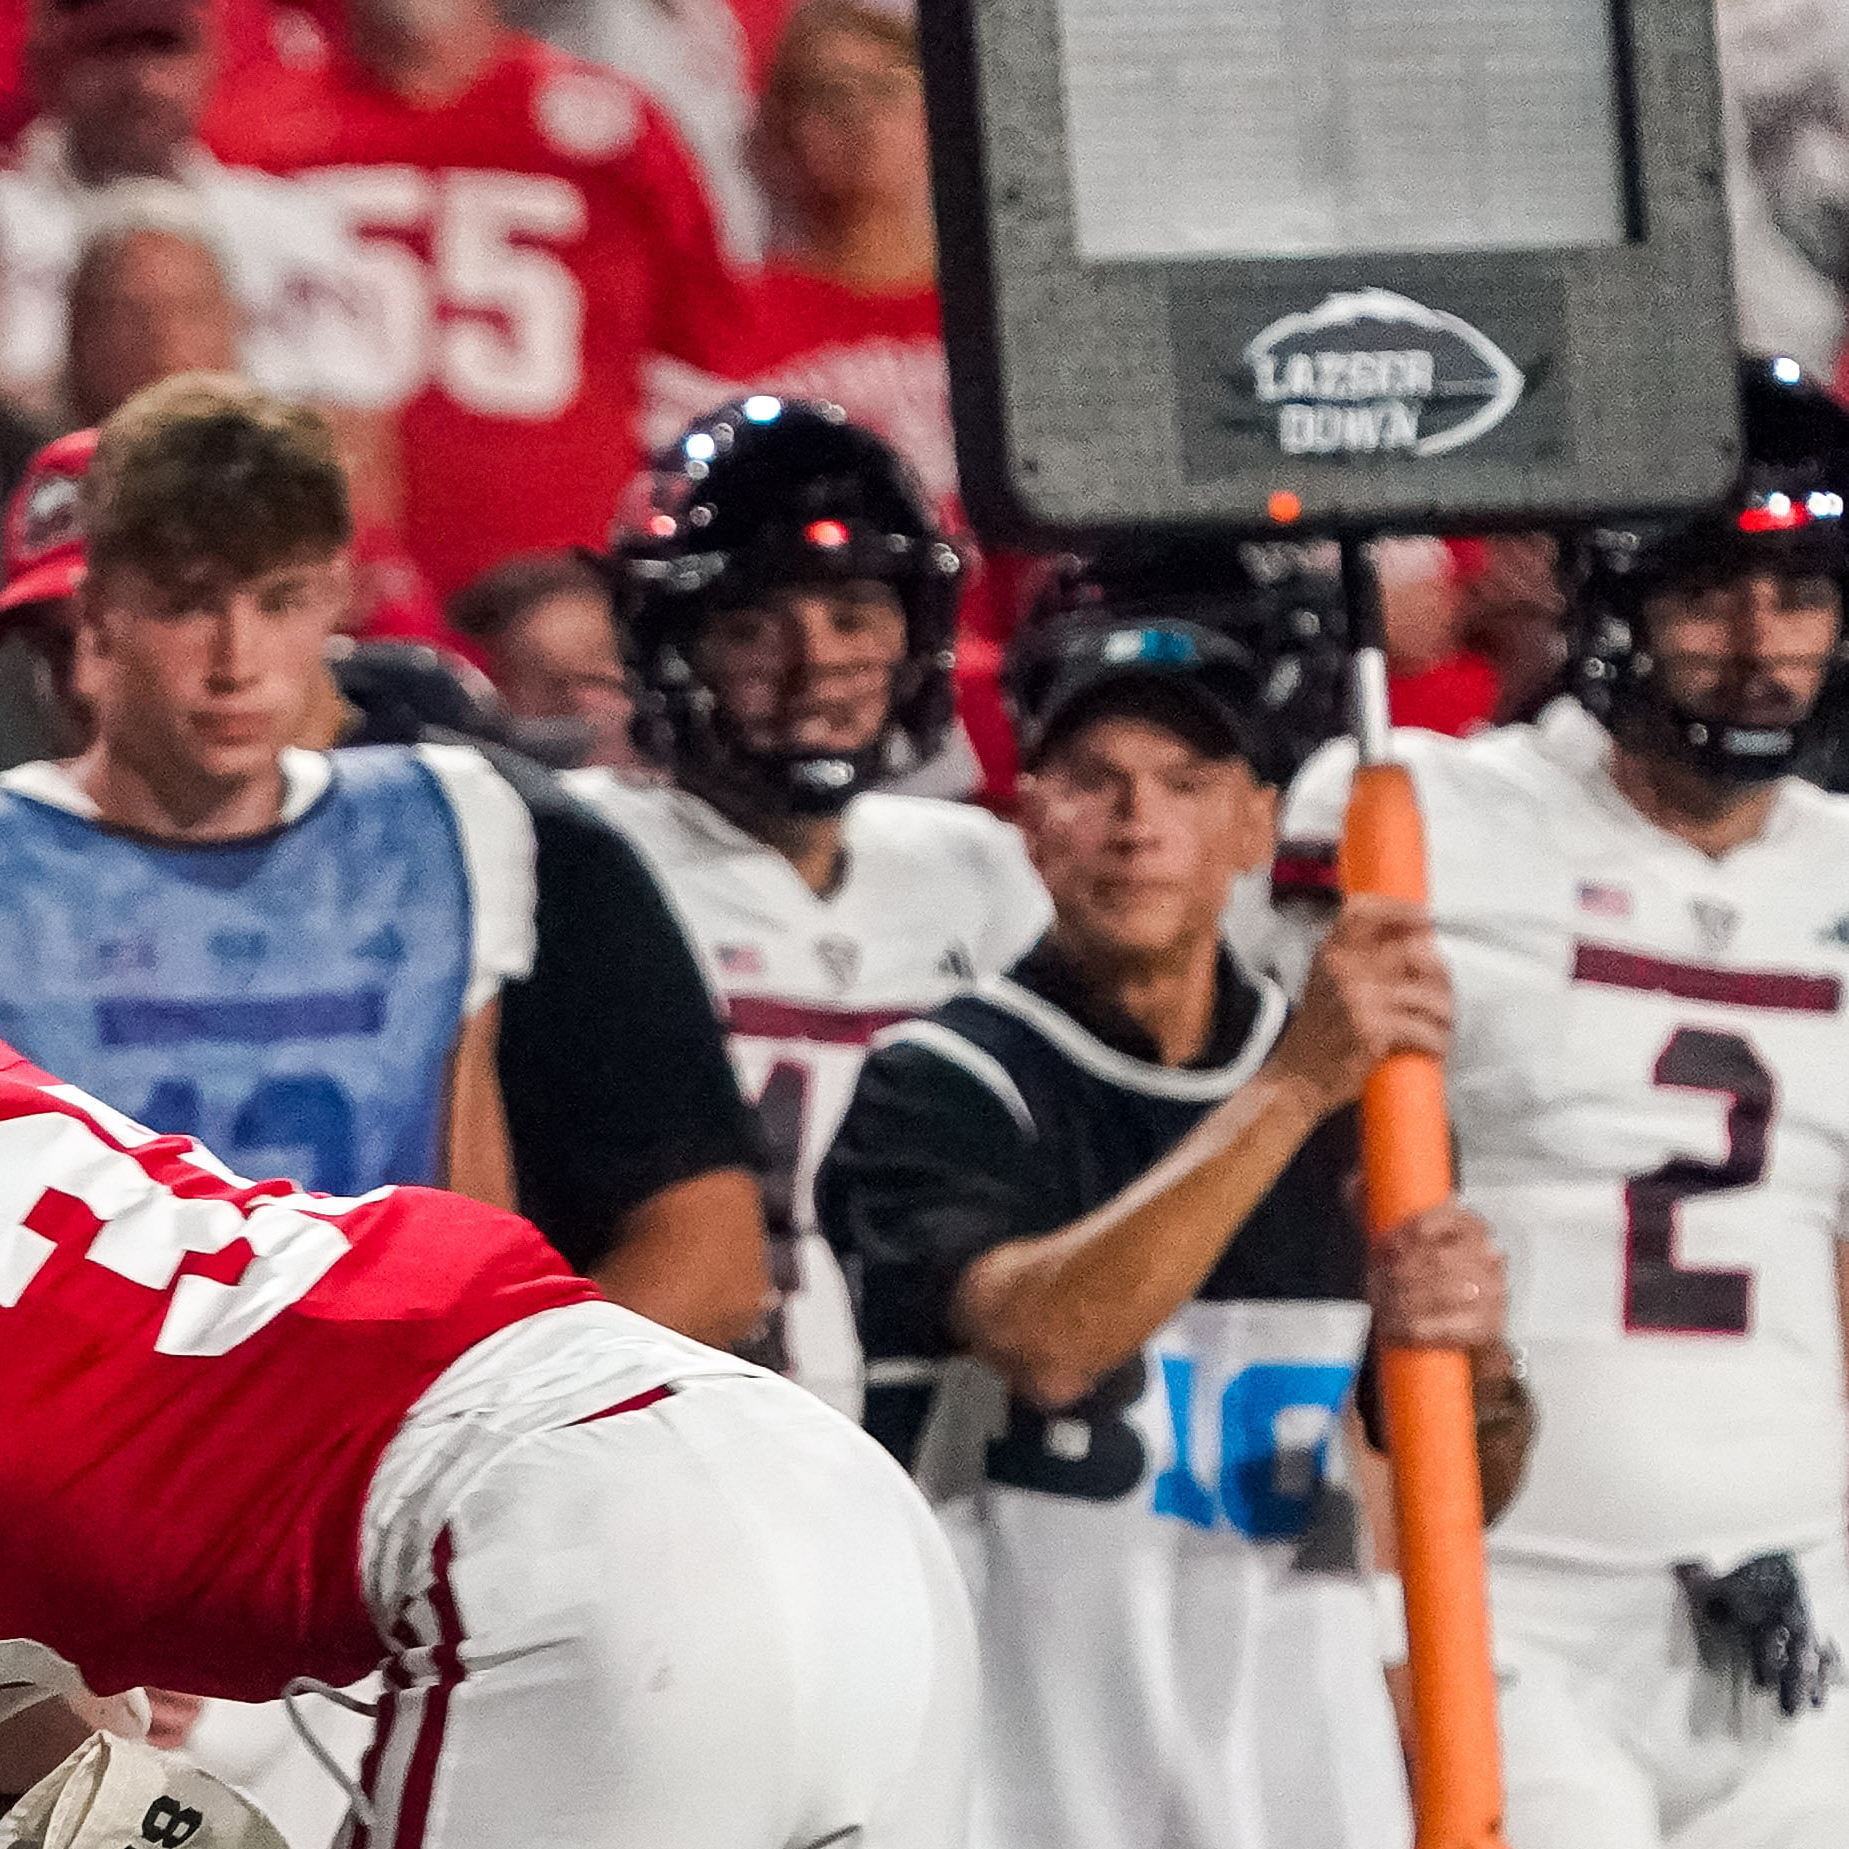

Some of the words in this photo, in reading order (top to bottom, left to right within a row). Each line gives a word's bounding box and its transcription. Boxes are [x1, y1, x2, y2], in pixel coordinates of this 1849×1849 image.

[264, 163, 588, 418] 55
[1280, 402, 1419, 453] DOWN
[1624, 1028, 1776, 1339] 2
